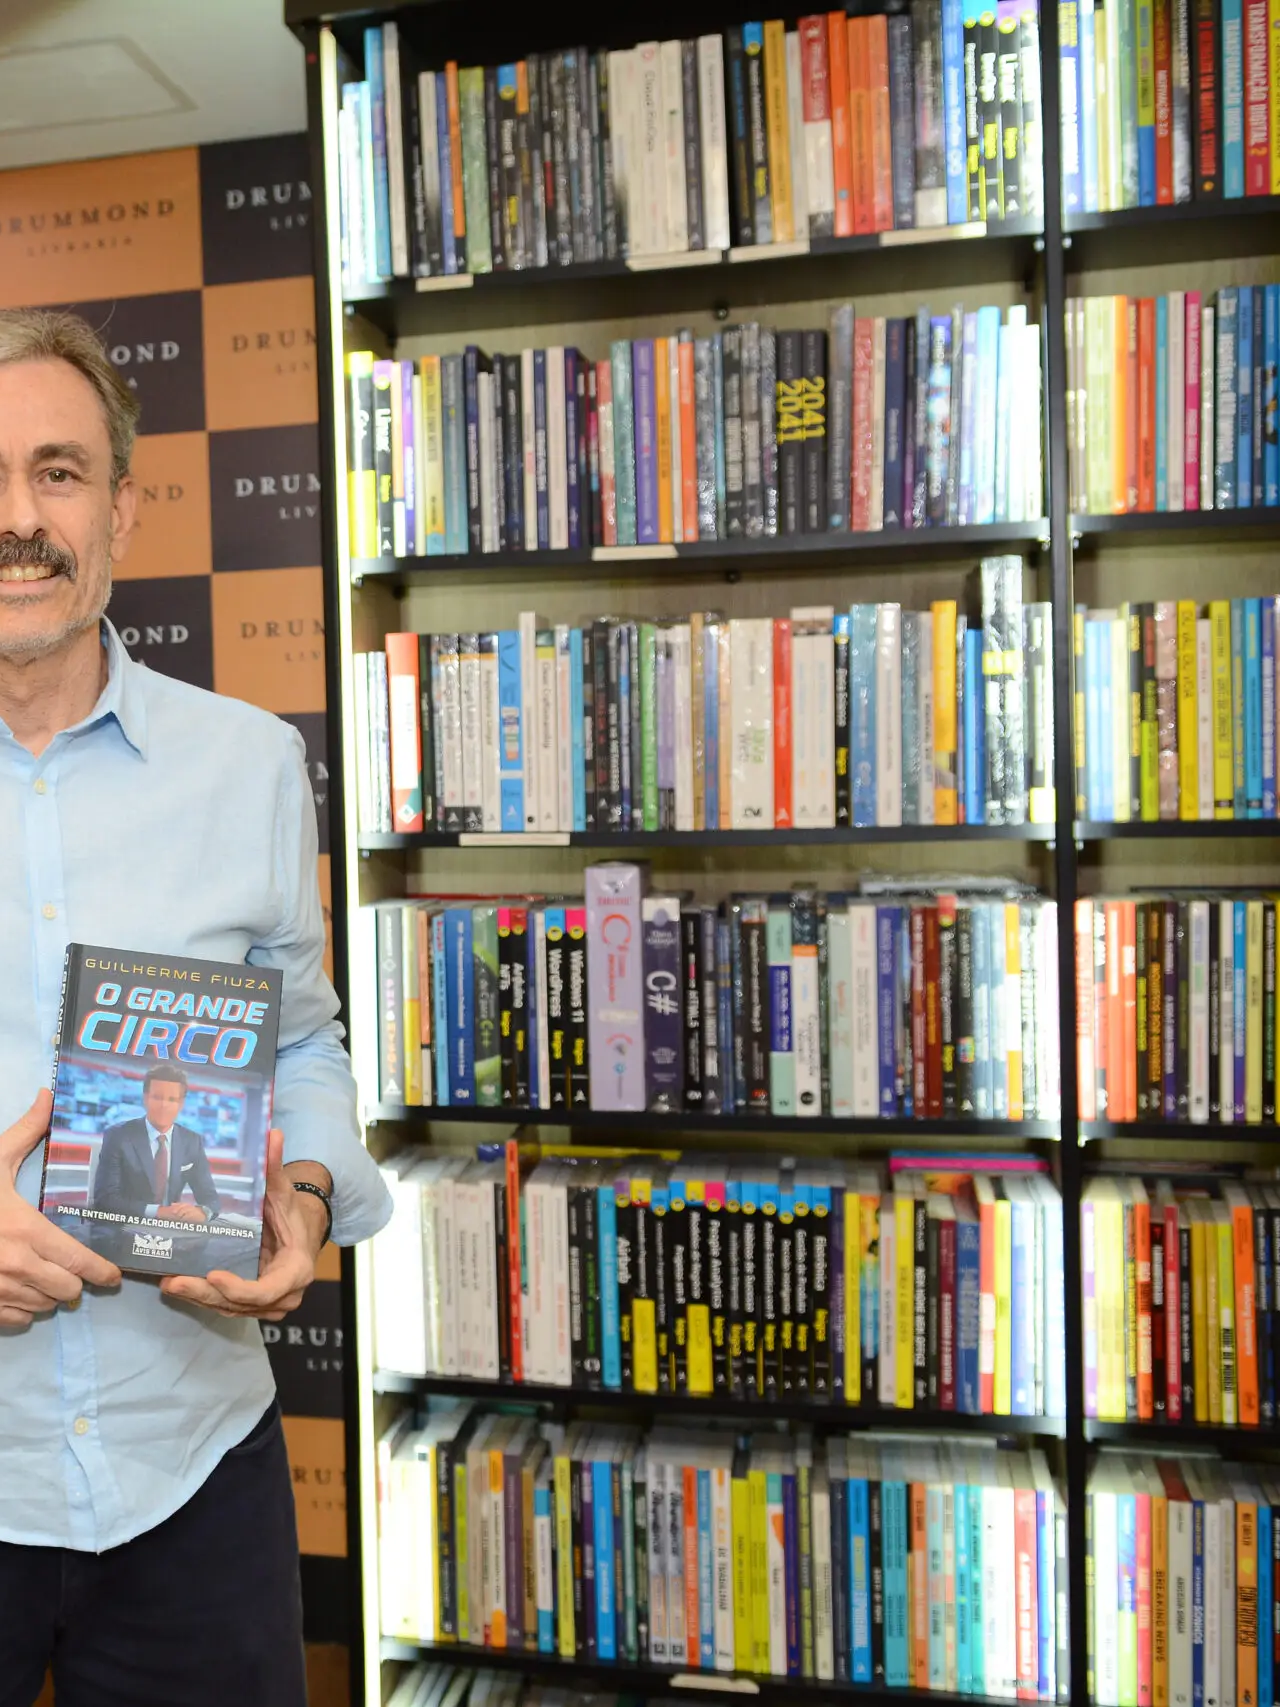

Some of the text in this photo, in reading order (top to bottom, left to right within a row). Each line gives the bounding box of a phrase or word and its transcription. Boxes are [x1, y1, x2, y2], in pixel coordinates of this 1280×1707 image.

[1247, 2, 1267, 156] TRANSFORMAÇÃO DIGITAL 2
[776, 379, 803, 445] 2041
[801, 377, 825, 440] 2041
[85, 958, 270, 991] GUILHERME FIUZA
[500, 964, 510, 990] NFTs
[512, 963, 524, 1008] Arduino
[548, 949, 563, 1017] WordPress
[571, 950, 584, 1007] Windows
[646, 970, 678, 1015] C#
[95, 982, 269, 1025] O GRANDE
[571, 1009, 584, 1023] 11
[78, 1011, 258, 1069] CIRCO
[480, 1019, 493, 1047] C++
[57, 1205, 254, 1239] PARA ENTENDER AS ACROBACIAS DA IMPRENSA
[709, 1219, 720, 1257] People
[744, 1222, 755, 1260] Hábitos
[617, 1238, 631, 1284] Airbnb
[745, 1263, 755, 1273] de
[813, 1236, 827, 1291] Eletrônica
[710, 1258, 723, 1309] Analytics
[745, 1275, 755, 1312] Sucesso
[796, 1276, 807, 1314] Produto
[1193, 1605, 1203, 1645] SONHOS
[1238, 1586, 1257, 1647] CONTROVERSO
[1156, 1630, 1165, 1662] NEWS
